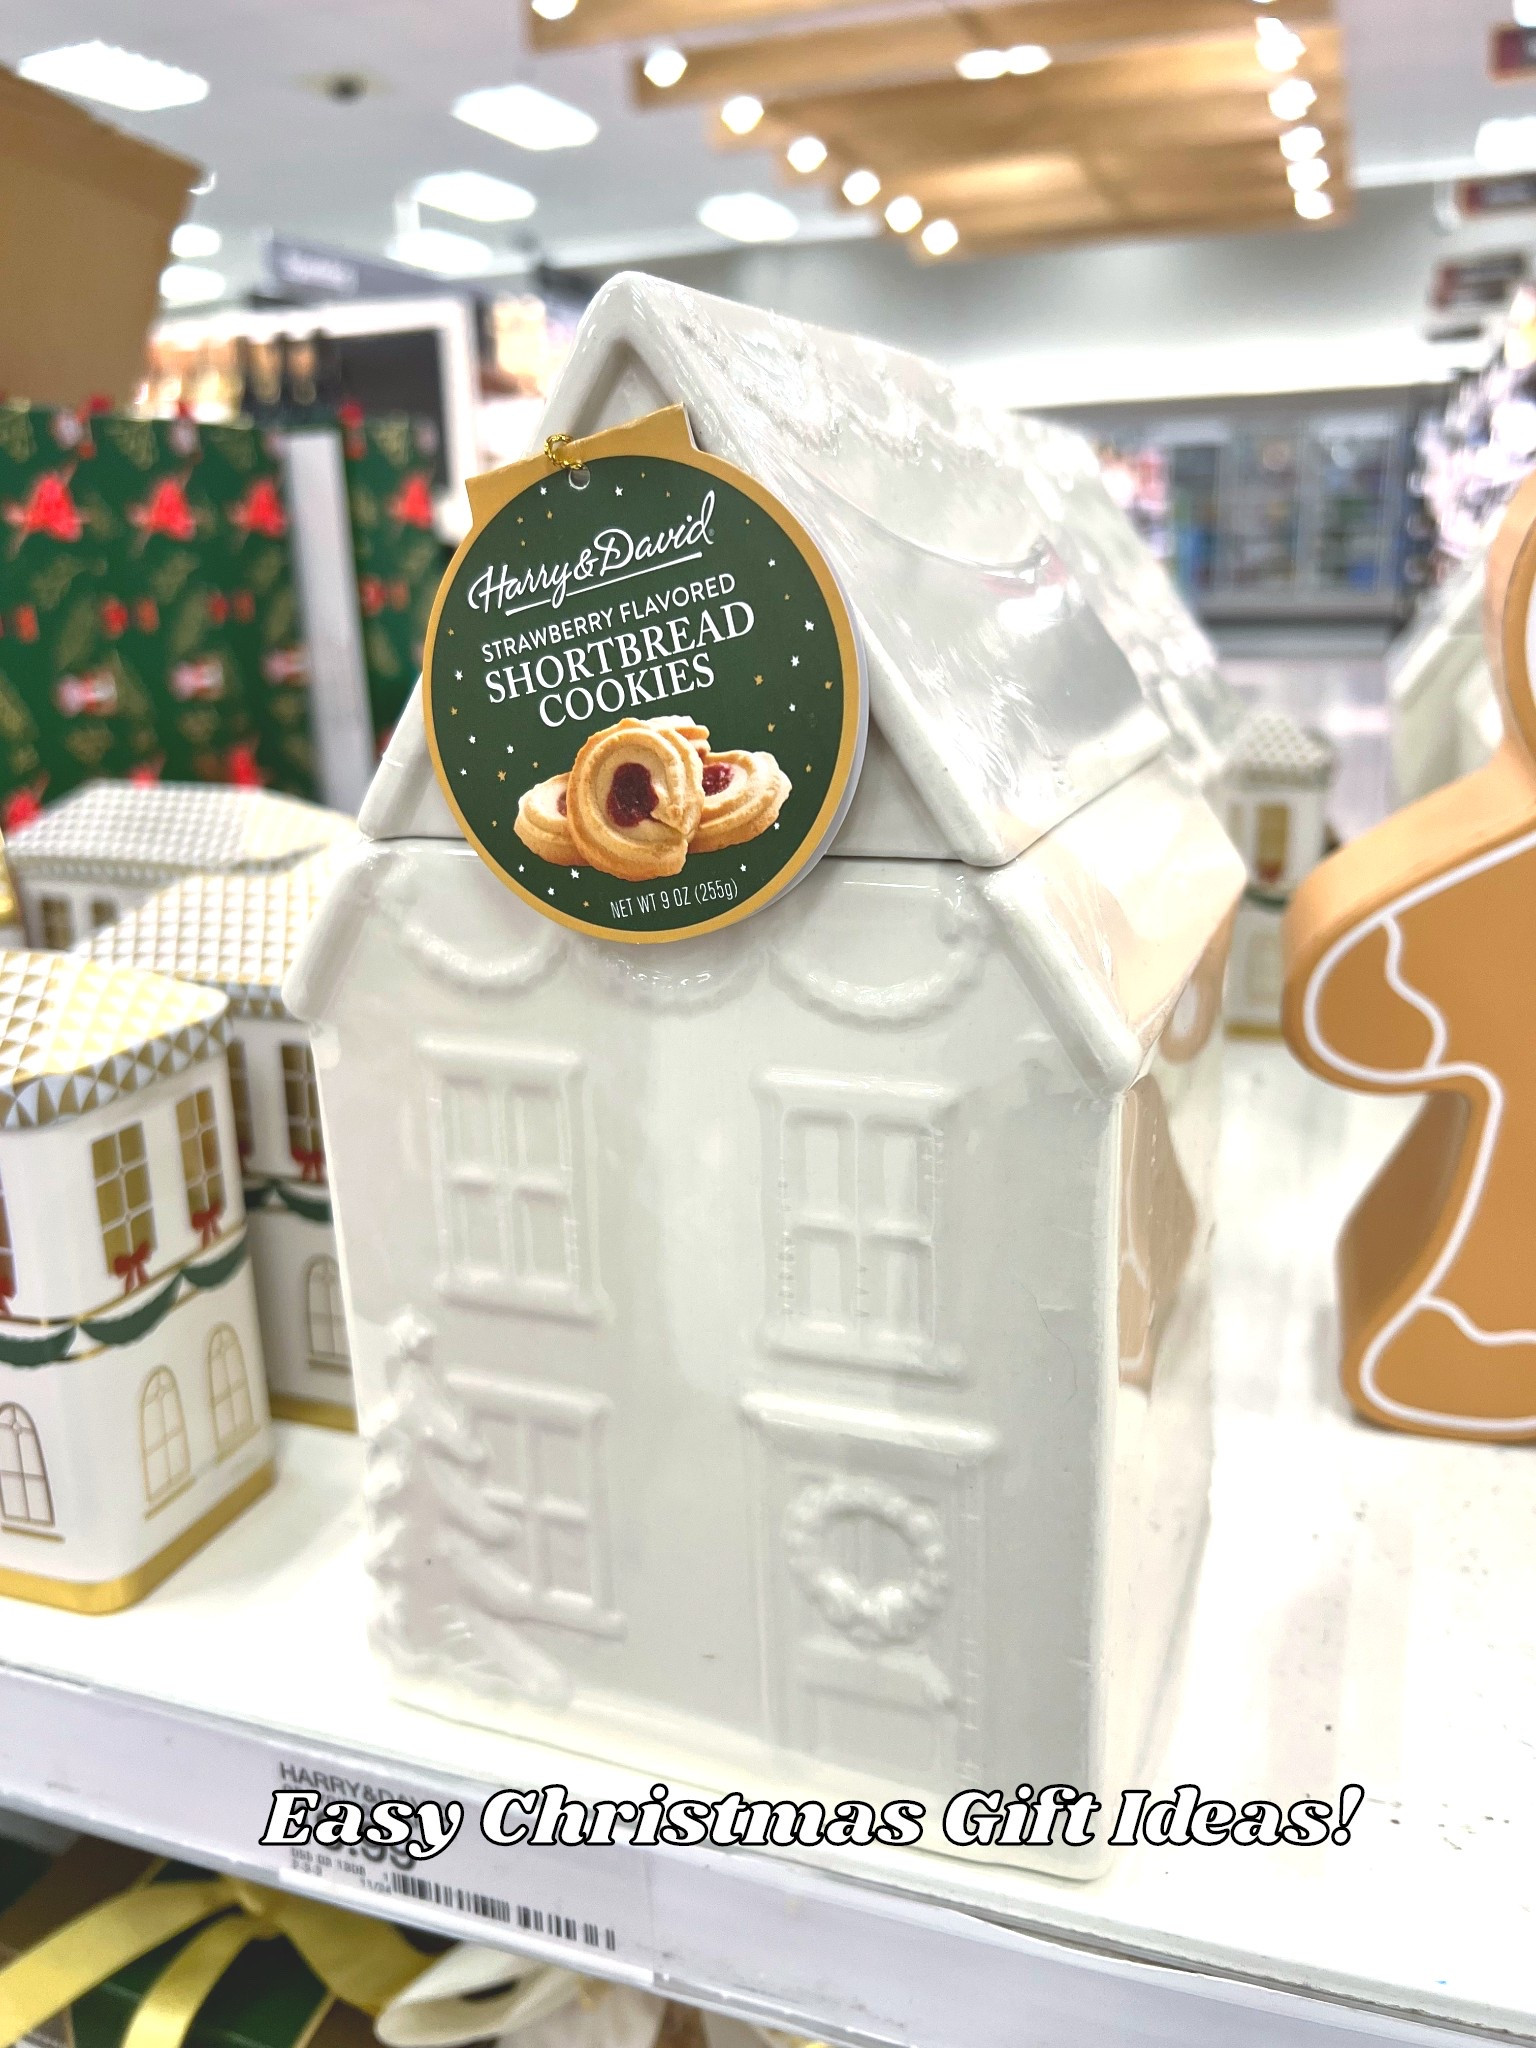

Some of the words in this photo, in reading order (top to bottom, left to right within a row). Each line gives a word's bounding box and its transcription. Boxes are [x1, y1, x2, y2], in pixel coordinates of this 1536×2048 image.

[481, 607, 613, 663] STRAWBERRY
[620, 573, 736, 623] FLAVORED
[484, 601, 755, 703] SHORTBREAD
[539, 652, 715, 728] COOKIES
[610, 897, 633, 919] NET
[636, 892, 657, 914] WT
[660, 890, 670, 909] 9
[673, 886, 691, 907] OZ
[694, 877, 738, 905] (255g)
